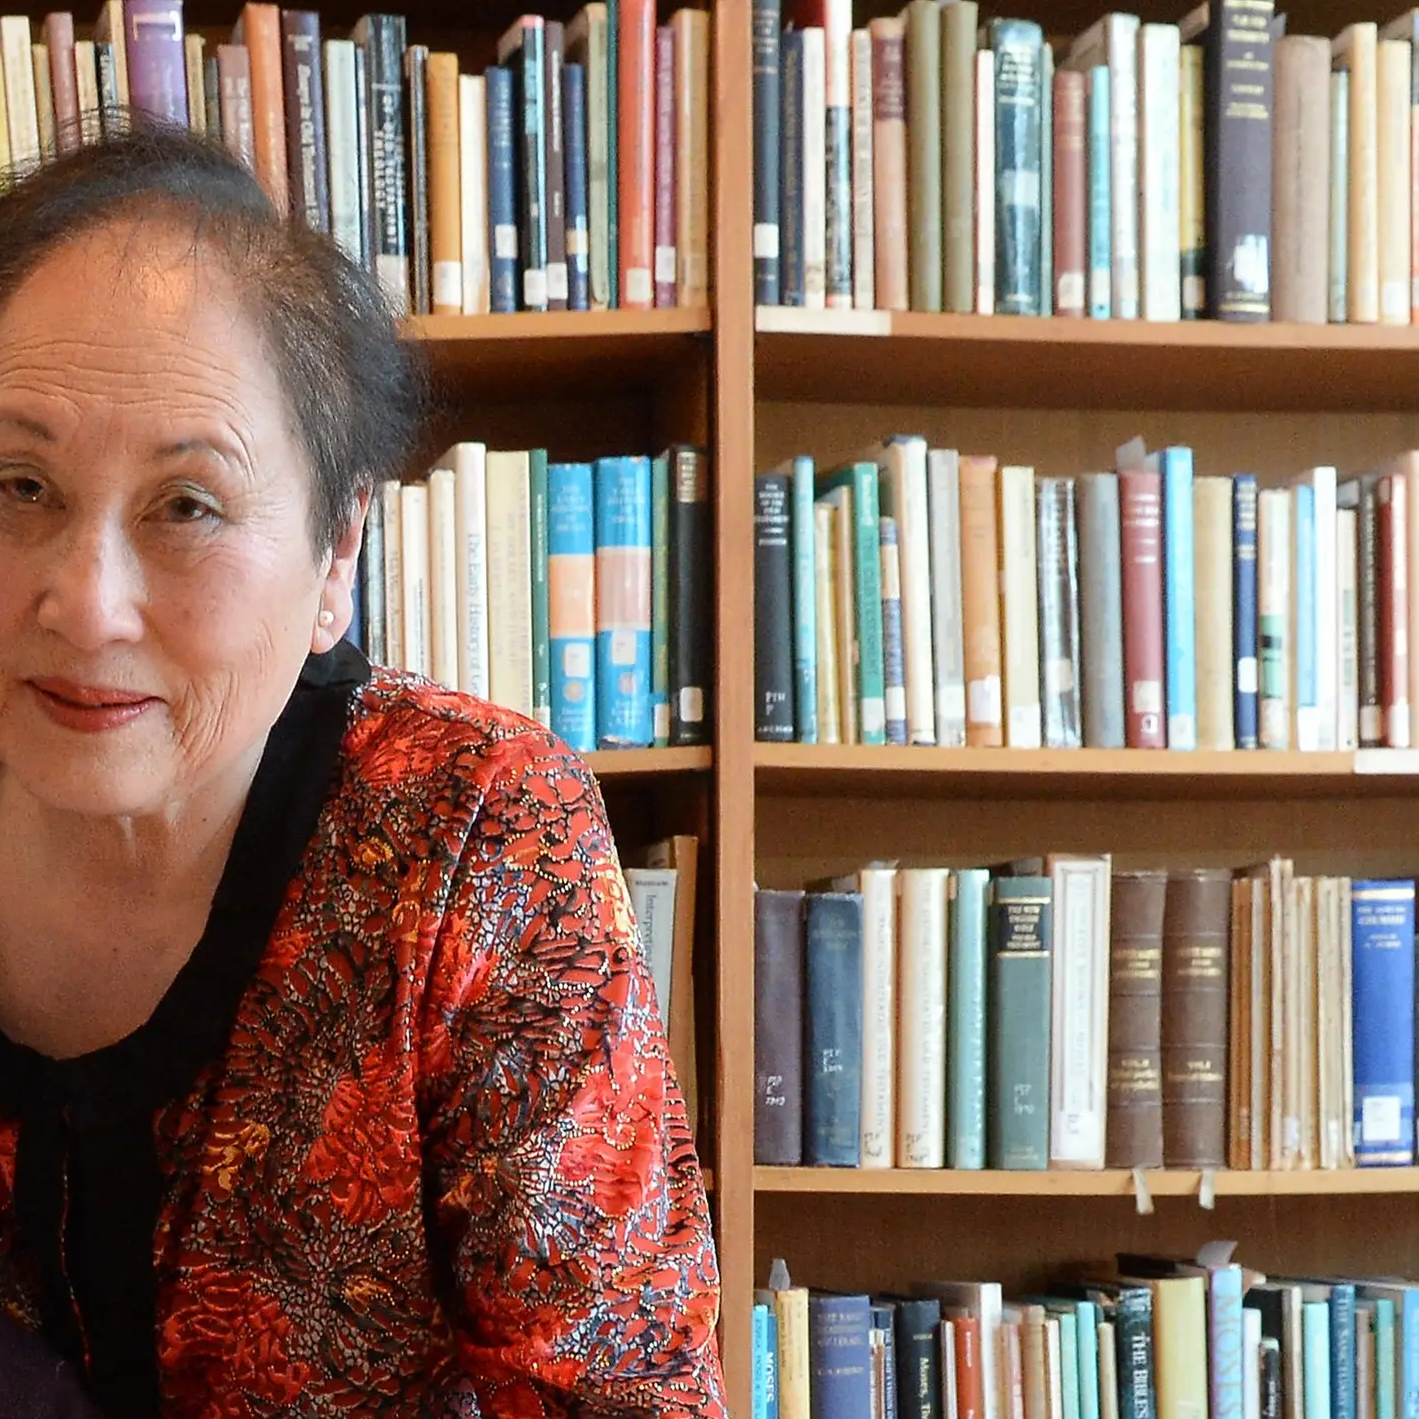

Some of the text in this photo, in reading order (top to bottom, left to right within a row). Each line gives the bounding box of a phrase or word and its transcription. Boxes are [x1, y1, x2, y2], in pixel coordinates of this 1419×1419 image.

[301, 121, 314, 144] Old
[302, 146, 317, 206] Testament
[864, 569, 876, 599] OLD
[466, 533, 483, 697] The Early History of Go
[865, 602, 878, 675] TESTAMENT
[876, 1069, 886, 1133] TESTAMENT
[921, 1071, 932, 1135] TESTAMENT
[1338, 1298, 1349, 1322] THE
[765, 1351, 775, 1403] MOSES
[918, 1357, 930, 1398] Moses,
[1131, 1332, 1151, 1365] THE
[1216, 1294, 1242, 1417] MOSES
[1339, 1329, 1351, 1405] SANCTUARY
